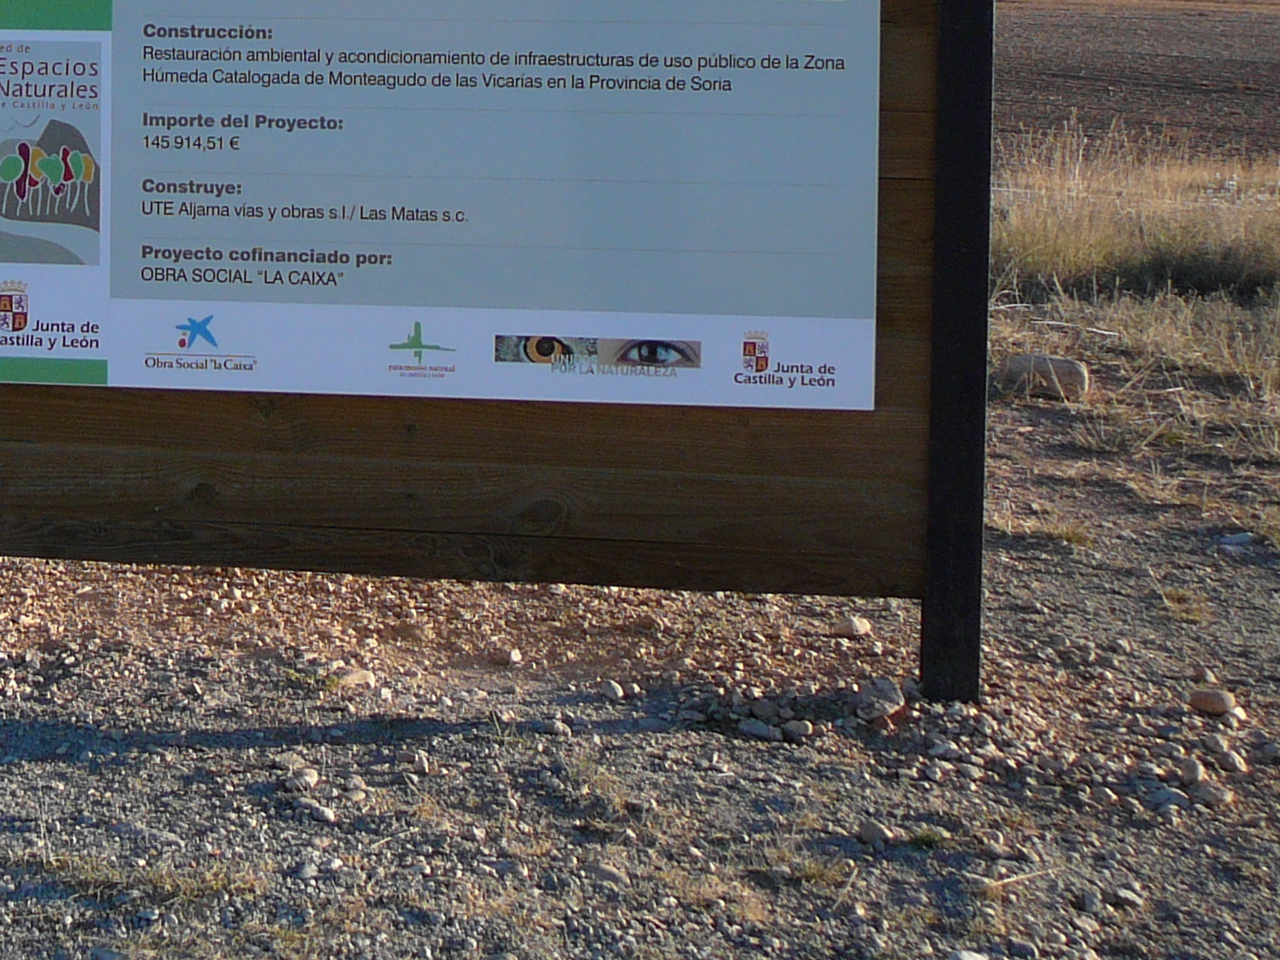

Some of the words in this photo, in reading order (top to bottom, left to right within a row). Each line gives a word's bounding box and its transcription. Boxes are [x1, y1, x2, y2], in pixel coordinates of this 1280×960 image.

[143, 24, 273, 40] Construcción:
[17, 45, 31, 53] de
[143, 46, 242, 61] Restauración
[246, 48, 321, 63] ambiental
[325, 52, 334, 66] y
[338, 49, 485, 65] acondicionamiento
[490, 51, 510, 65] de
[514, 52, 634, 67] infraestructuras
[638, 53, 659, 68] de
[663, 56, 693, 68] uso
[697, 53, 756, 71] público
[760, 54, 781, 69] de
[785, 54, 799, 69] la
[803, 55, 845, 70] Zona
[143, 68, 208, 83] Húmeda
[212, 69, 300, 87] Catalogada
[304, 71, 324, 85] de
[328, 71, 427, 89] Monteagudo
[431, 73, 451, 87] de
[455, 73, 477, 87] las
[482, 73, 542, 89] Vicarías
[547, 77, 566, 89] en
[571, 75, 584, 89] la
[589, 75, 661, 90] Provincia
[665, 77, 686, 91] de
[690, 77, 732, 91] Soria
[12, 101, 55, 109] Castilla
[72, 102, 99, 110] León
[143, 113, 215, 130] Importe
[221, 114, 249, 128] del
[255, 115, 343, 132] Proyecto:
[229, 137, 240, 150] €
[142, 179, 242, 197] Construye:
[142, 201, 174, 216] UTE
[178, 202, 229, 220] Aljama
[234, 202, 263, 218] vías
[268, 207, 277, 221] y
[281, 204, 324, 219] obras
[360, 206, 387, 221] Las
[391, 207, 438, 222] Matas
[442, 211, 468, 222] s.c.
[141, 245, 223, 262] Proyecto
[229, 248, 351, 264] cofinanciado
[355, 253, 392, 267] por:
[141, 267, 187, 282] OBRA
[192, 269, 253, 284] SOCIAL
[32, 319, 75, 334] Junta
[79, 320, 100, 334] de
[47, 338, 57, 350] y
[62, 335, 99, 348] León
[145, 357, 173, 368] Obra
[176, 359, 208, 370] Social
[774, 362, 815, 376] Junta
[818, 364, 835, 375] de
[734, 372, 784, 386] Castilla
[787, 376, 797, 388] y
[801, 374, 835, 387] León
